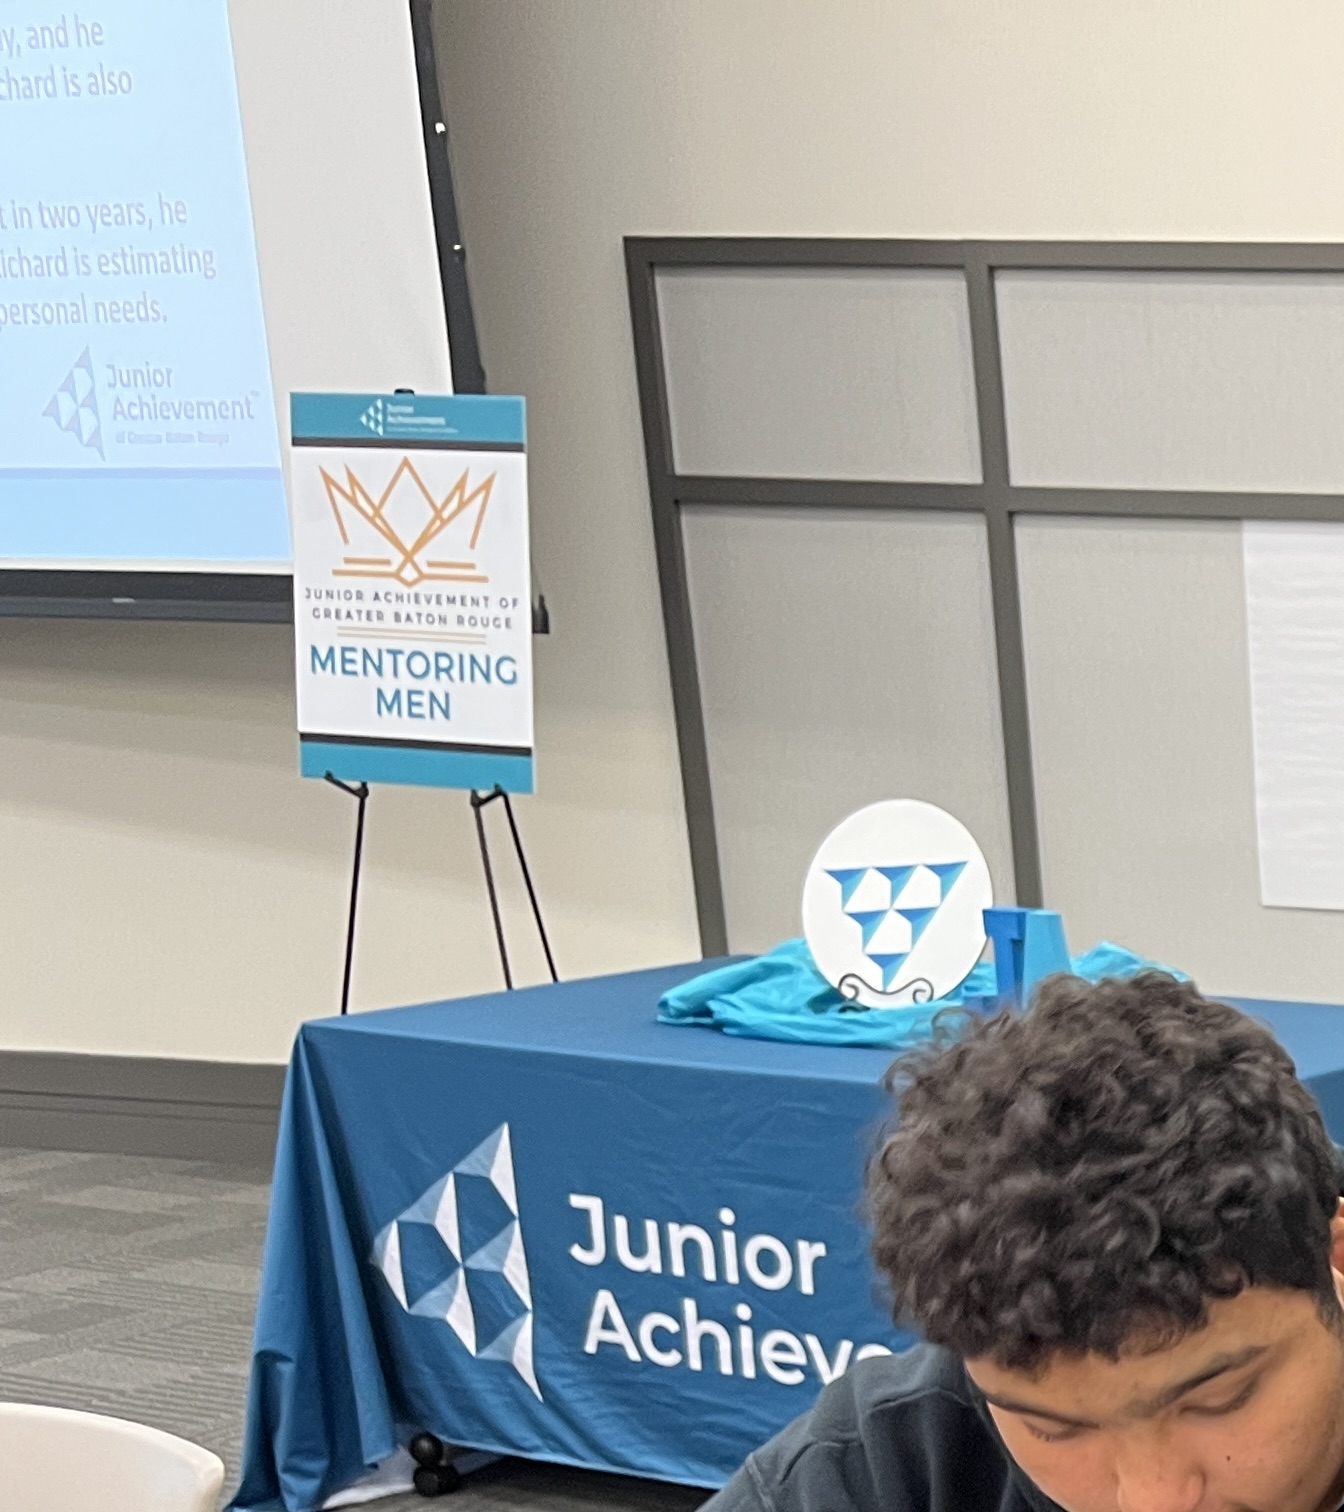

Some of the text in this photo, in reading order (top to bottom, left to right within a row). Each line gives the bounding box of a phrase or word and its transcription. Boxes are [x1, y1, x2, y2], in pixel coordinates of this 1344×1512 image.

[27, 14, 69, 49] and
[75, 13, 104, 47] he
[62, 66, 81, 97] is
[88, 63, 132, 96] also
[11, 199, 33, 229] in
[38, 200, 81, 229] two
[86, 201, 152, 234] years,
[158, 192, 188, 225] he
[0, 243, 217, 279] ichard is estimating
[94, 291, 168, 324] needs.
[106, 361, 173, 388] Junior
[112, 395, 255, 420] Achievement
[305, 588, 519, 609] JUNIOR ACHIEVEMENT OF
[312, 607, 513, 629] GREATER BATON ROUGE
[310, 645, 518, 685] MENTORING
[376, 687, 451, 721] MEN
[568, 1194, 827, 1295] Junior
